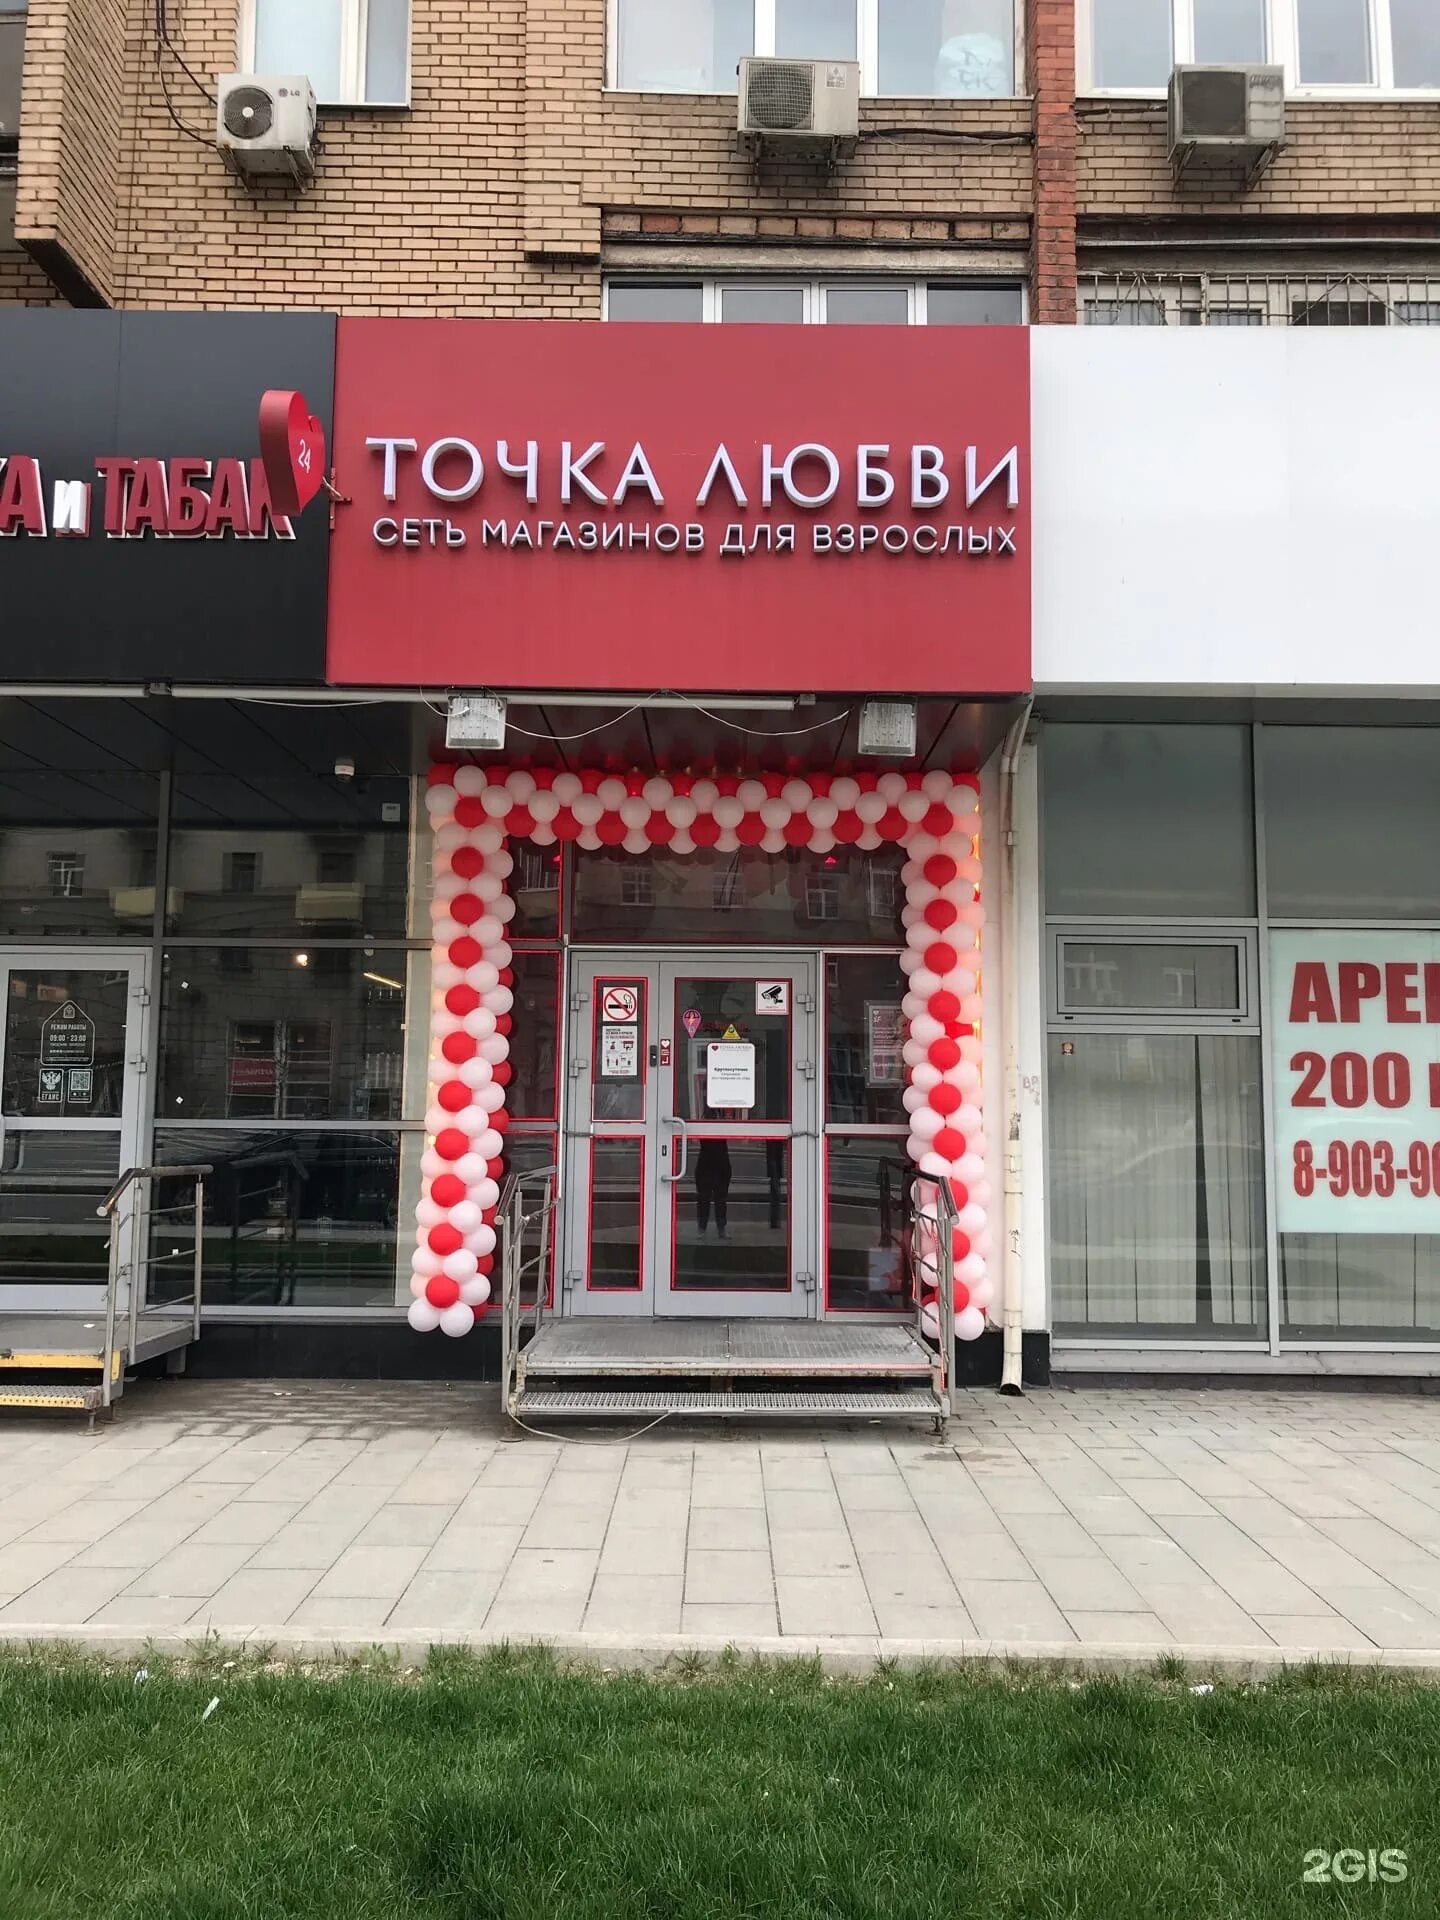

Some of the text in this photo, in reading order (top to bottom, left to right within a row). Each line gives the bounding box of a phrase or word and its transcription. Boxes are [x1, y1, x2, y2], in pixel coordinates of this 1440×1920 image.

[298, 438, 312, 474] 24
[365, 437, 1019, 509] ТОЧКА ЛЮБВИ
[0, 454, 47, 537] А
[372, 517, 1017, 557] СЕТЬ МАГАЗИНОВ ДЛЯ ВЗРОСЛЫХ
[1289, 1051, 1411, 1109] 200
